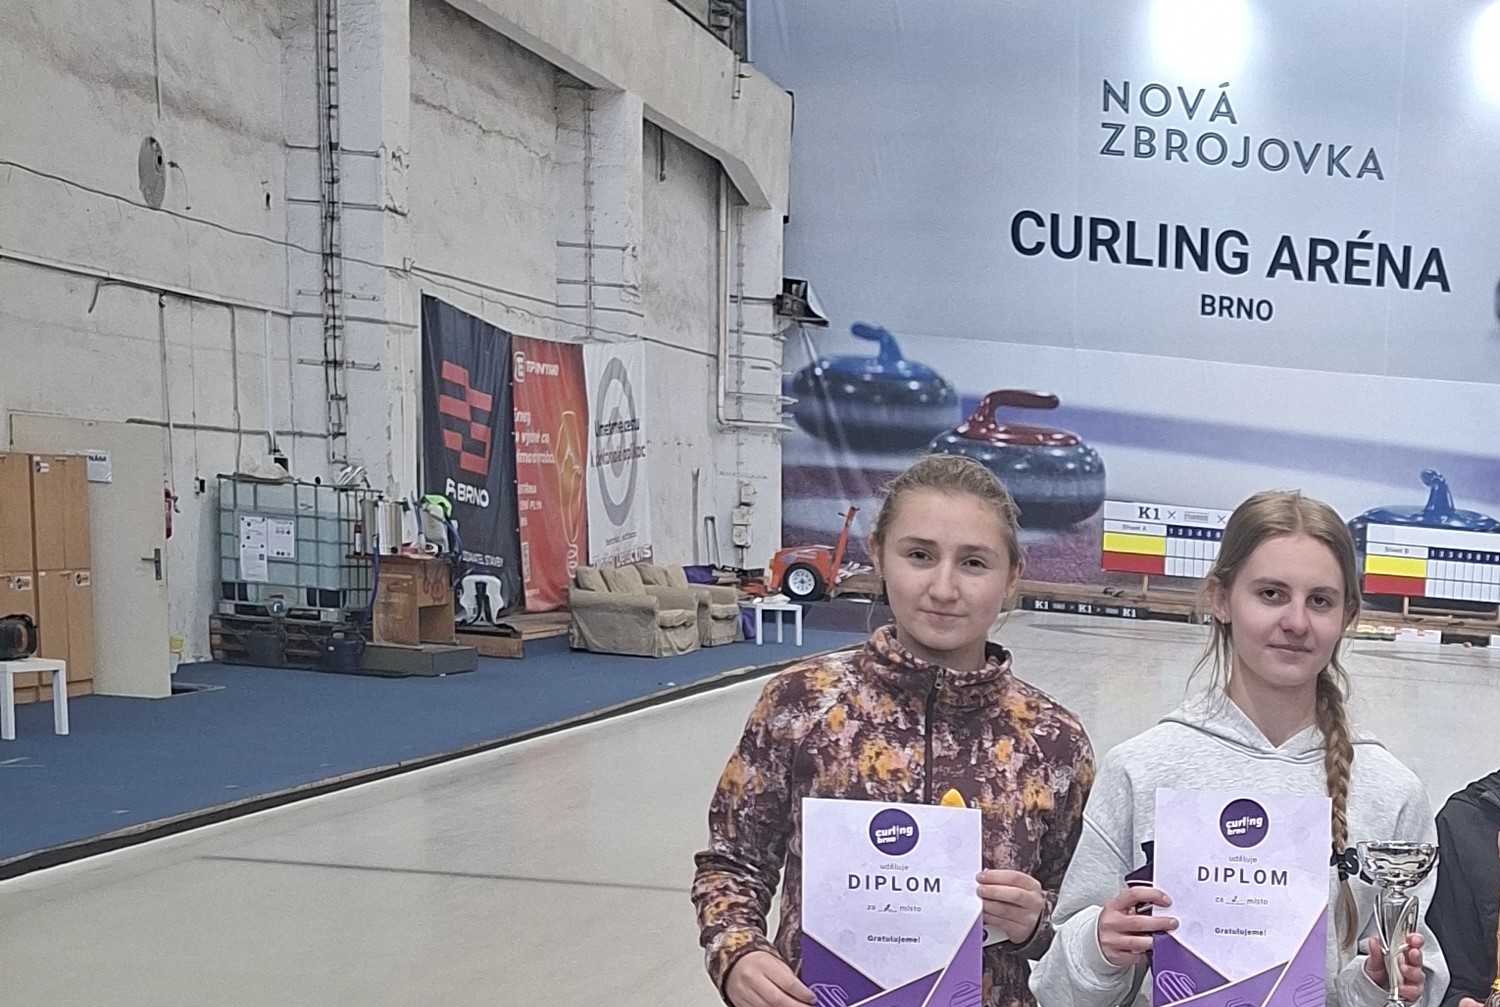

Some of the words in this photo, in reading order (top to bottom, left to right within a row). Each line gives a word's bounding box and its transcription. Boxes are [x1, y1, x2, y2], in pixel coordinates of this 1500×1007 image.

[1102, 79, 1238, 125] NOVÁ
[1100, 122, 1385, 181] ZBROJOVKA
[1011, 210, 1249, 276] CURLING
[1265, 230, 1452, 293] ARÉNA
[1200, 293, 1273, 321] BRNO
[457, 483, 489, 508] BRNO
[1138, 507, 1161, 520] K1
[1034, 600, 1049, 610] K1
[1078, 604, 1093, 614] K1
[1122, 608, 1137, 618] K1
[848, 874, 941, 893] DIPLOM
[1197, 866, 1288, 886] DIPLOM
[867, 934, 921, 945] Gratulujeme!
[1215, 926, 1267, 937] Gratulujeme!
